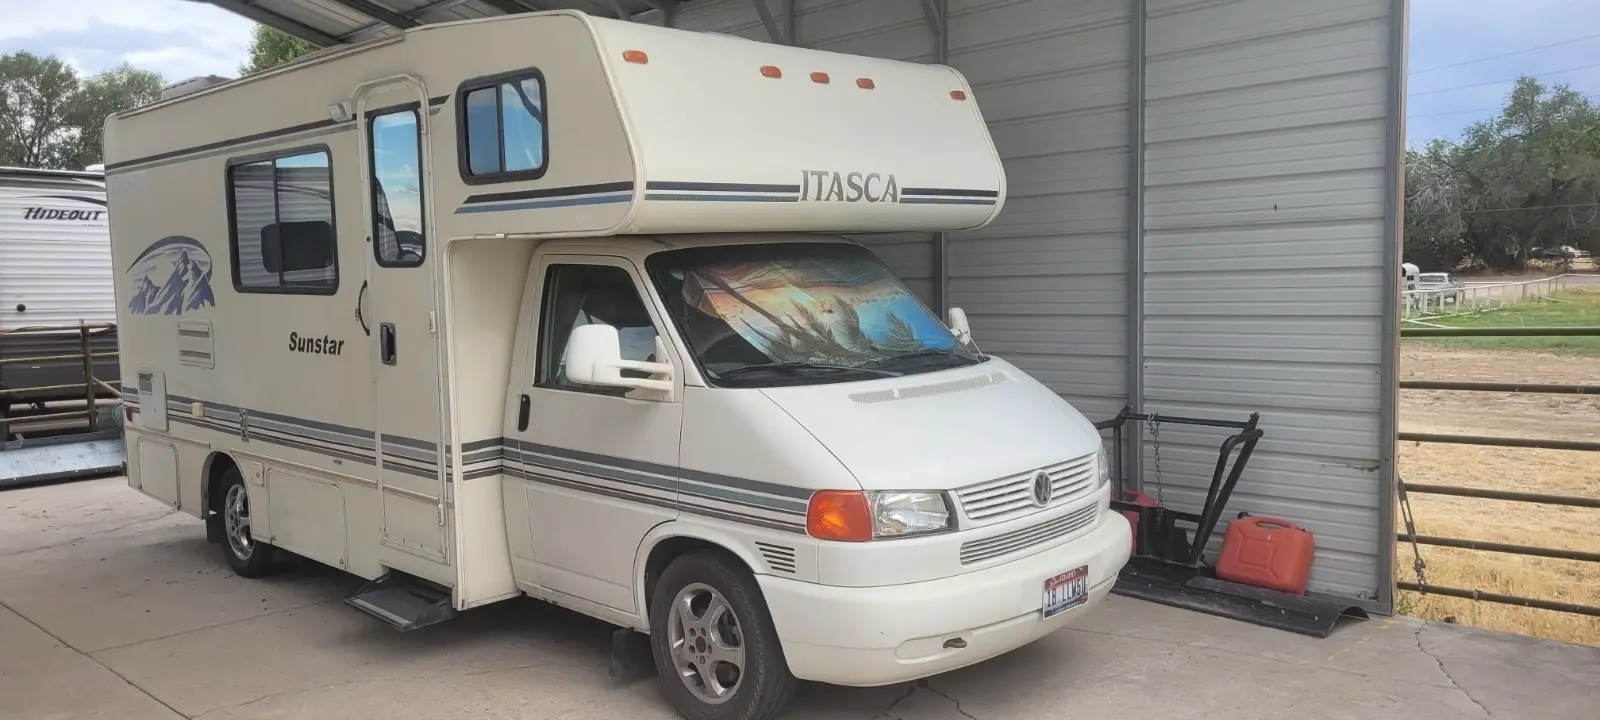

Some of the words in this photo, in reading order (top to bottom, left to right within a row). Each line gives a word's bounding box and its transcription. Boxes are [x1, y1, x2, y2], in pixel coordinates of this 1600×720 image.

[800, 170, 898, 202] ITASCA
[22, 207, 106, 220] HIDEOUT
[288, 331, 344, 355] Sunstar
